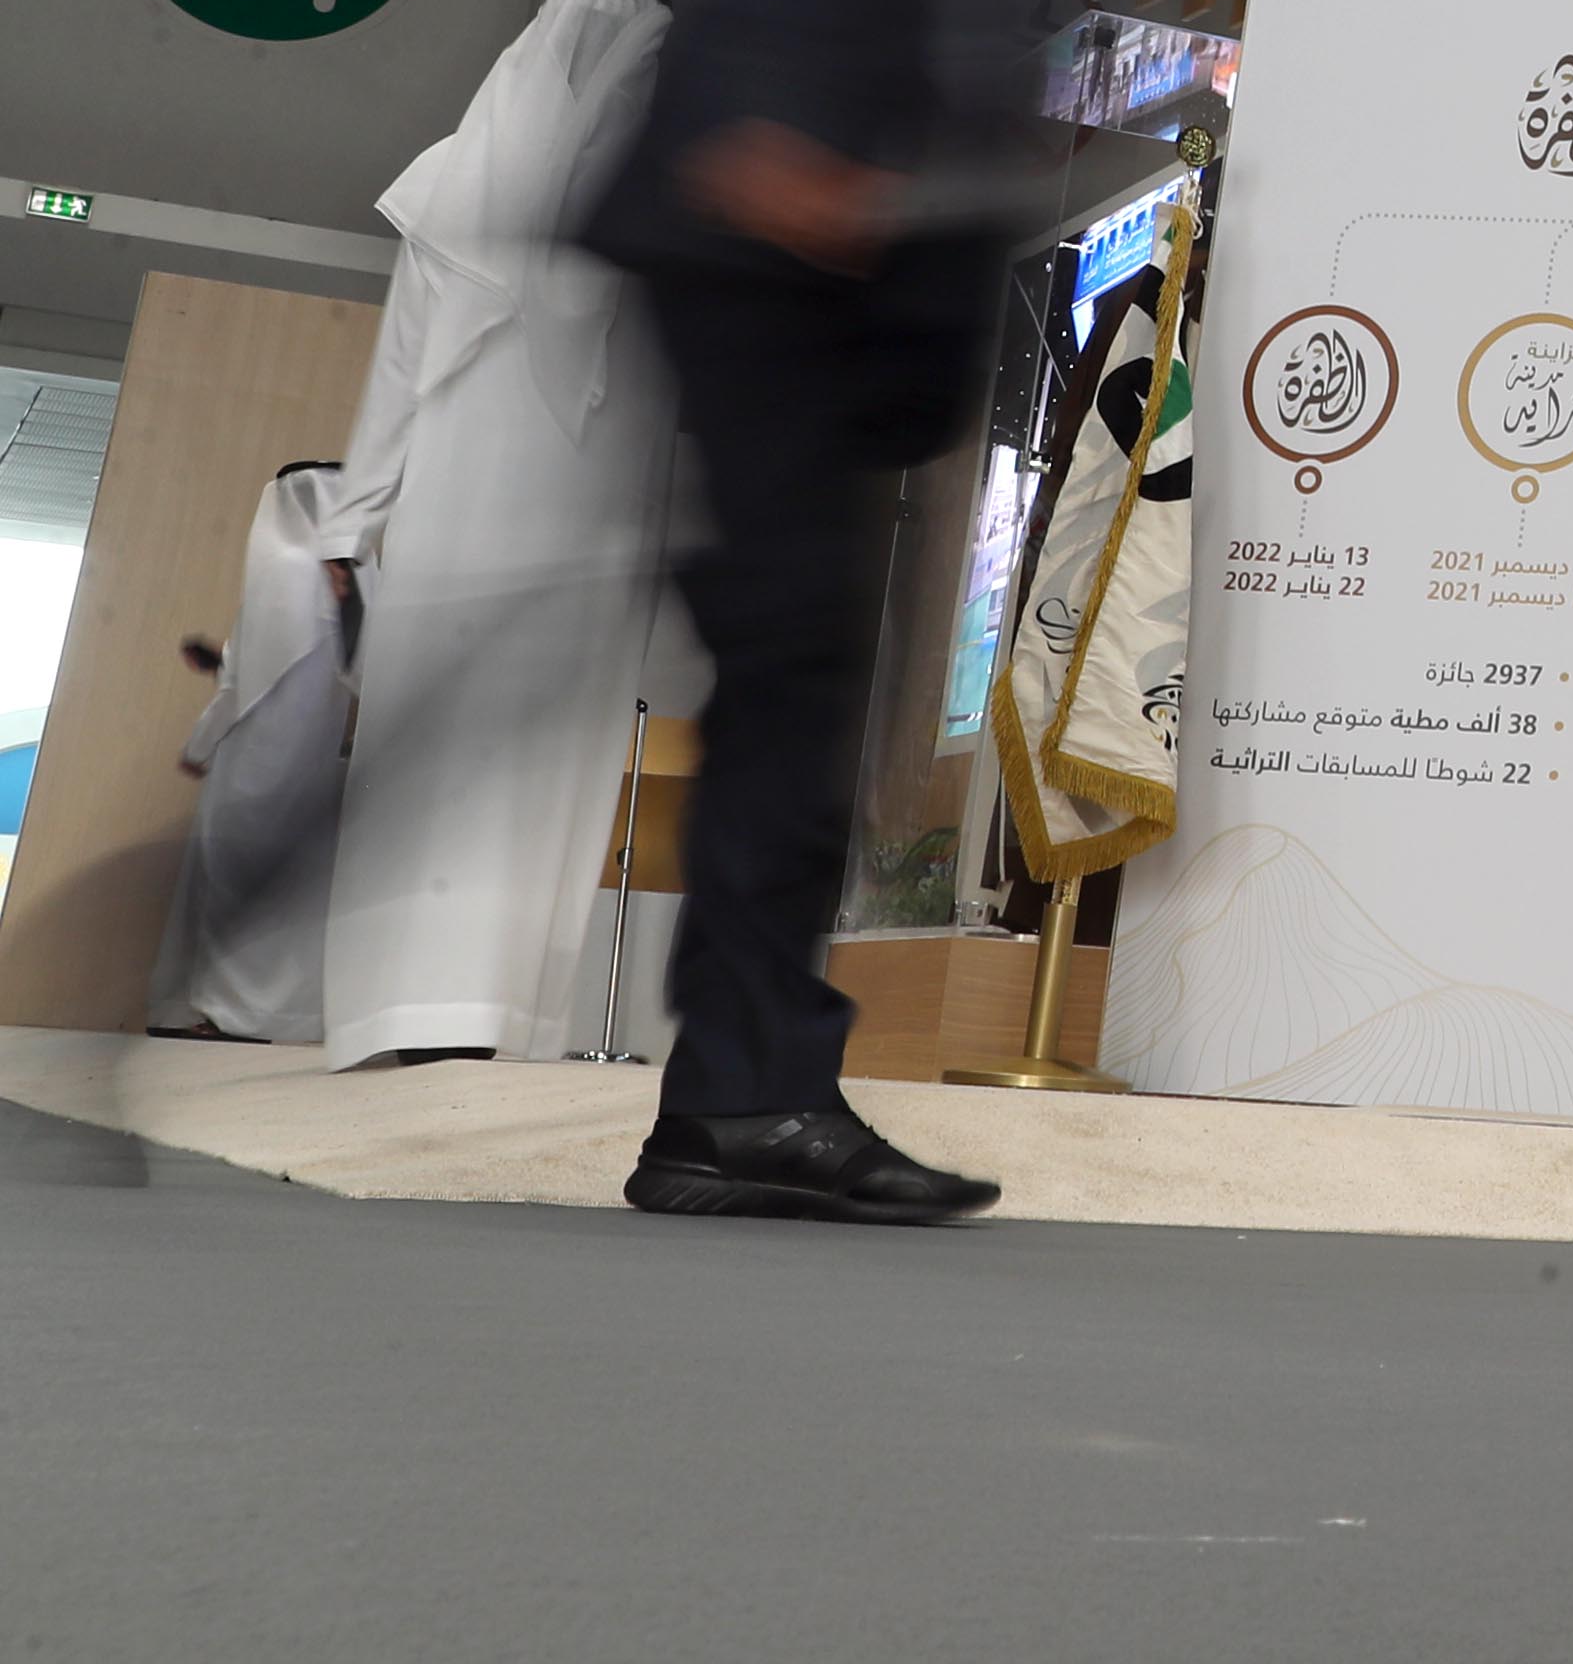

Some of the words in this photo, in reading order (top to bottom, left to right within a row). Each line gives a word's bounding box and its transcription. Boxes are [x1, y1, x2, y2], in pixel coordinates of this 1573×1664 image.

[1227, 541, 1281, 564] 2022
[1287, 545, 1335, 569] يناير
[1344, 546, 1370, 567] 13
[1430, 550, 1485, 572] 2021
[1491, 559, 1569, 580] ديسمبر
[1223, 571, 1277, 593] 2022
[1283, 576, 1331, 600] يناير
[1338, 576, 1366, 597] 22
[1426, 580, 1482, 602] 2021
[1487, 589, 1565, 611] ديسمبر
[1425, 662, 1475, 688] جائزة
[1482, 662, 1543, 686] 2937
[1211, 698, 1306, 727] مشاركتها
[1313, 709, 1382, 733] متوقع
[1390, 708, 1449, 734] مطية
[1456, 706, 1501, 733] ألف
[1507, 713, 1538, 735] 38
[1209, 746, 1290, 776] التراثية
[1296, 754, 1417, 780] للمسابقات
[1502, 763, 1532, 785] 22
